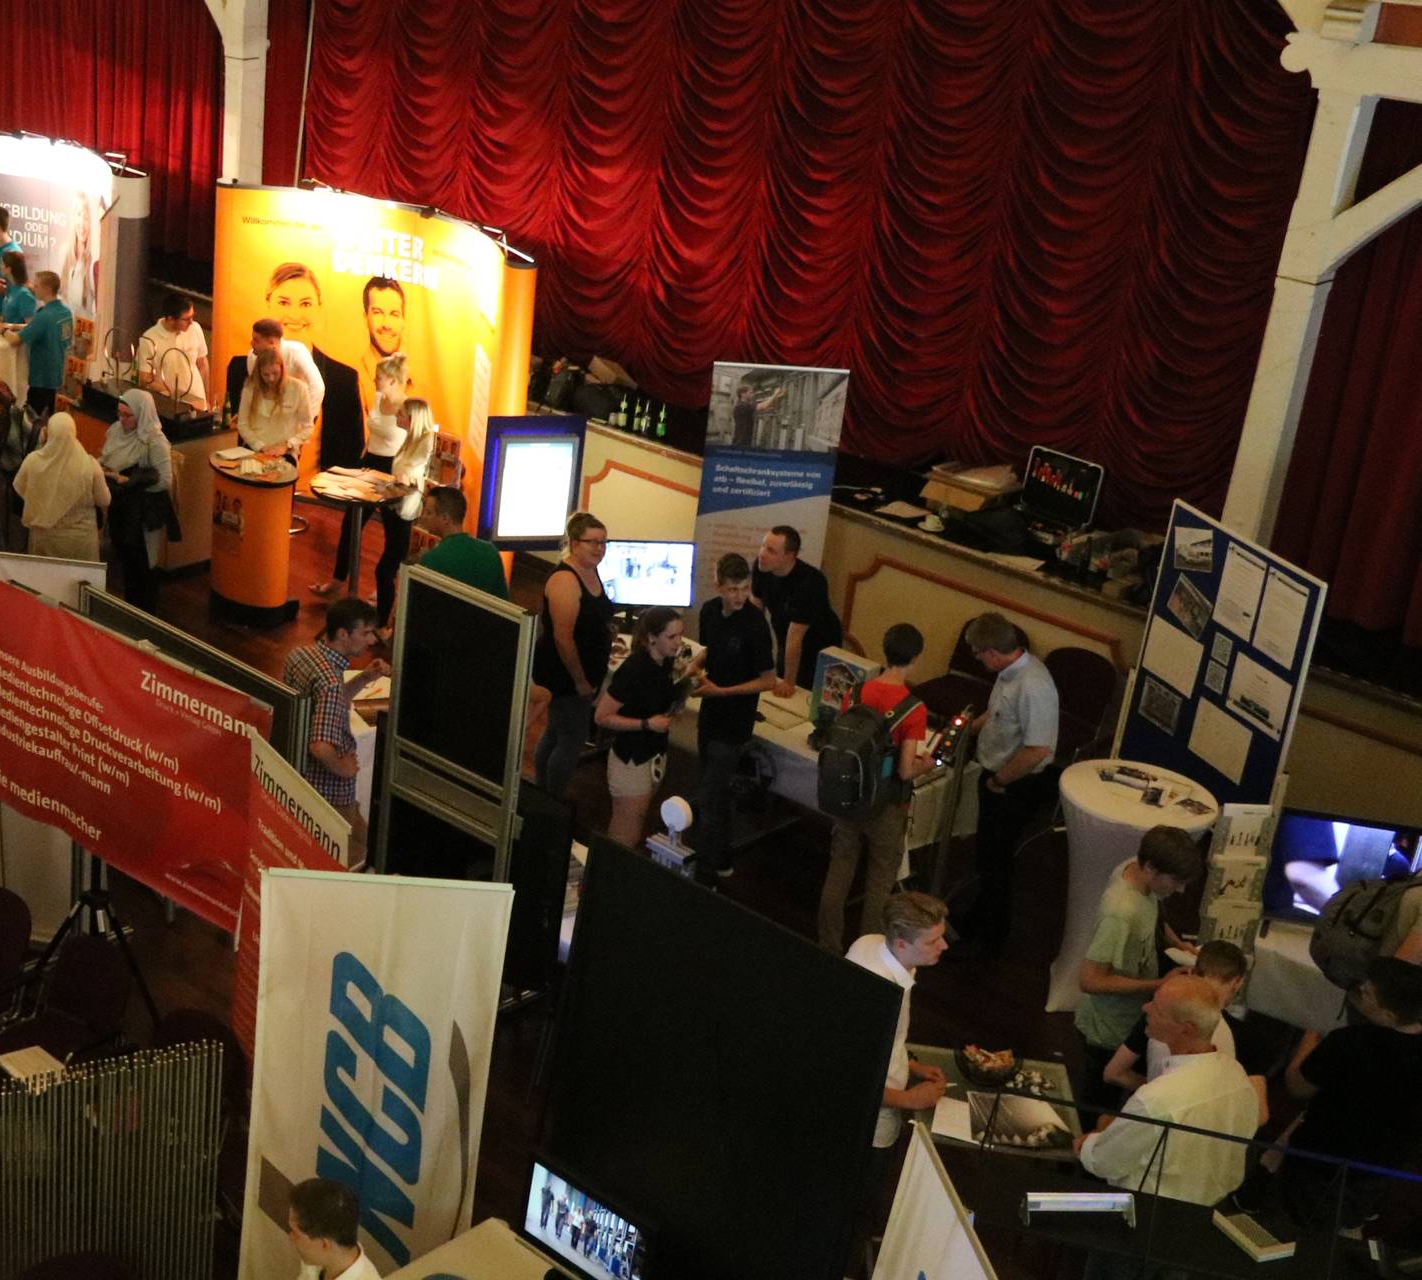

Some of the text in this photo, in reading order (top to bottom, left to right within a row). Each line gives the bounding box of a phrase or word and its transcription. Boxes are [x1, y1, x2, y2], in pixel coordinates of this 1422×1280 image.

[9, 230, 57, 249] DIUM?
[24, 221, 50, 233] ODER
[712, 486, 729, 494] und
[21, 662, 105, 713] Ausbildungsberufe:
[72, 743, 96, 768] Print
[98, 754, 130, 788] (w/m)
[83, 711, 143, 754] Offsetdruck
[145, 743, 179, 775] (w/m)
[82, 730, 182, 796] Druckverarbeitung
[184, 783, 222, 815] (w/m)
[10, 780, 102, 842] medienmacher
[252, 754, 341, 863] Zimmermann
